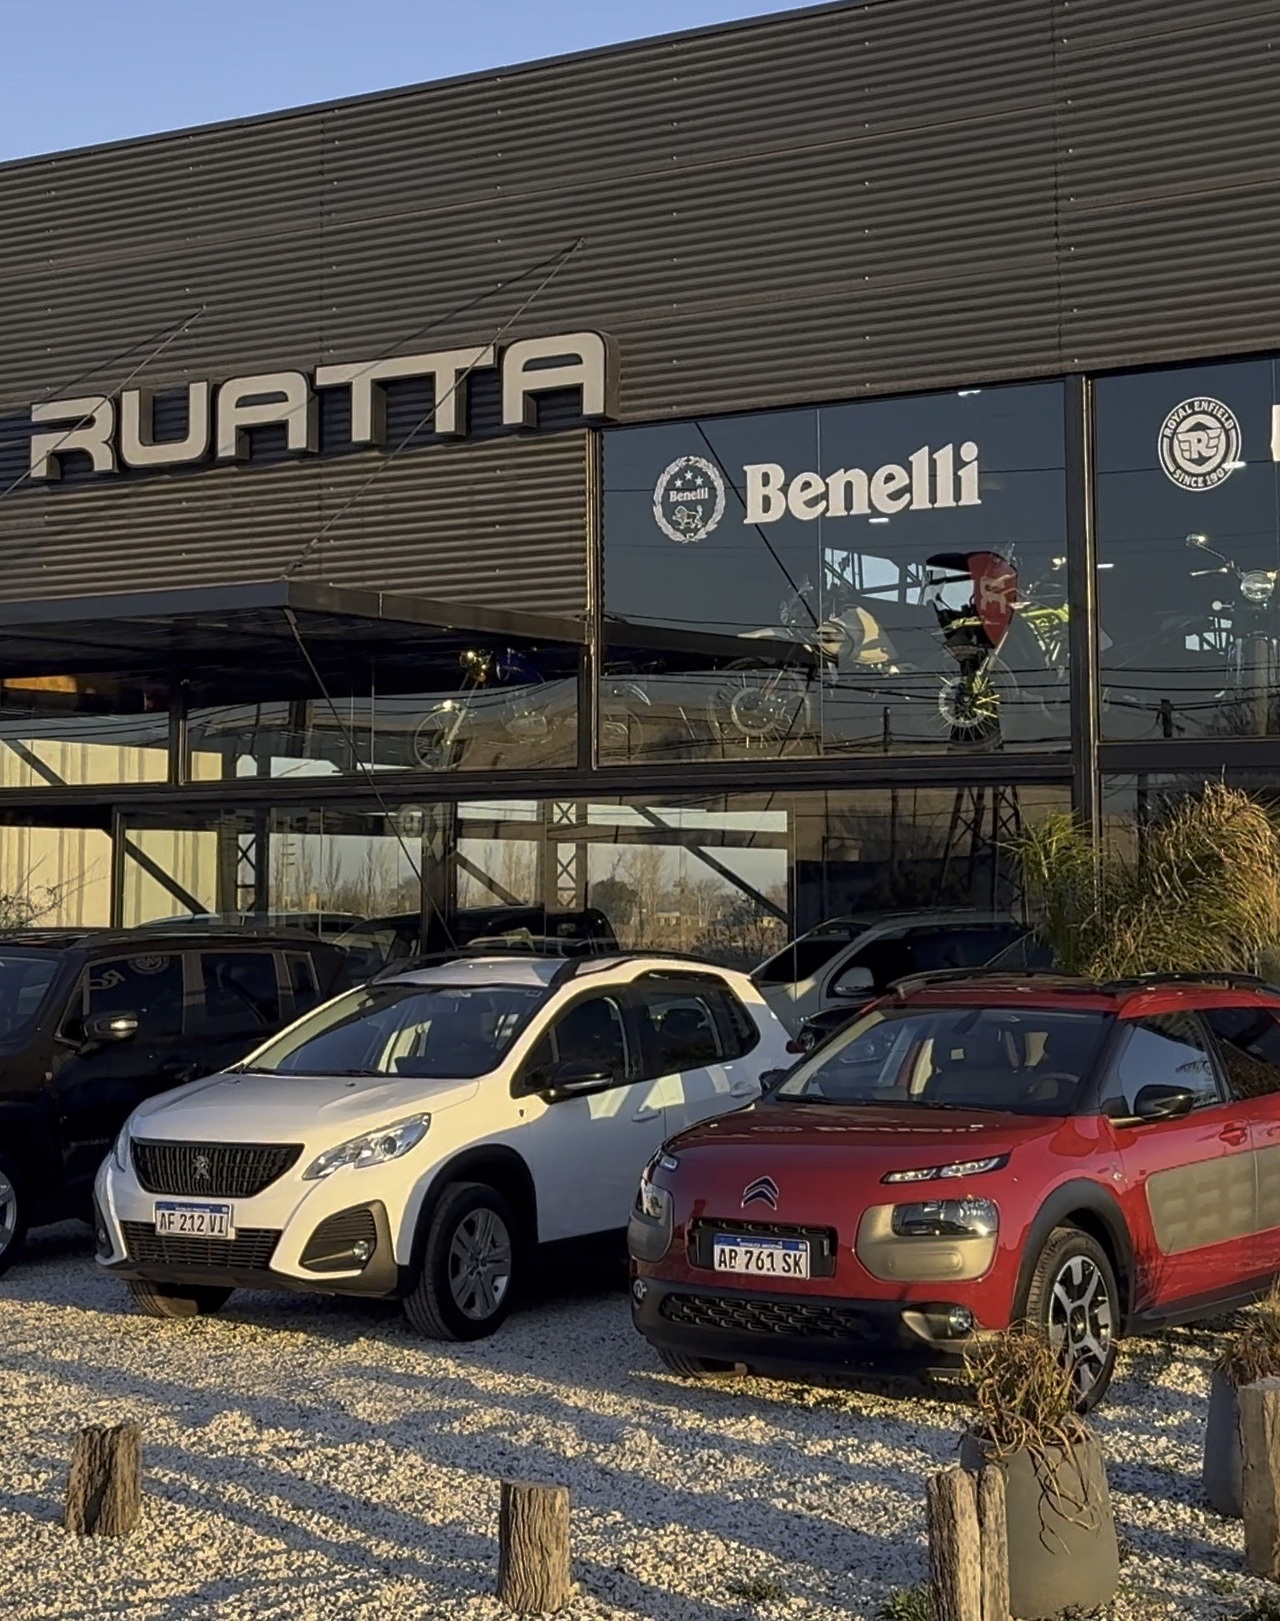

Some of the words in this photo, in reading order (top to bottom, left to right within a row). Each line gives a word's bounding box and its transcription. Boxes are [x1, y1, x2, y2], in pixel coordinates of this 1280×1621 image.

[30, 331, 610, 481] RUATTA
[1163, 404, 1193, 437] ROYAL
[1194, 401, 1235, 430] ENFIELD
[743, 441, 982, 524] Benelli
[1173, 469, 1205, 487] SINCE
[669, 488, 709, 502] Benelli
[160, 1212, 175, 1231] AF
[179, 1213, 205, 1233] 212
[209, 1214, 224, 1234] VI
[744, 1250, 776, 1273] 761
[782, 1252, 803, 1275] SK
